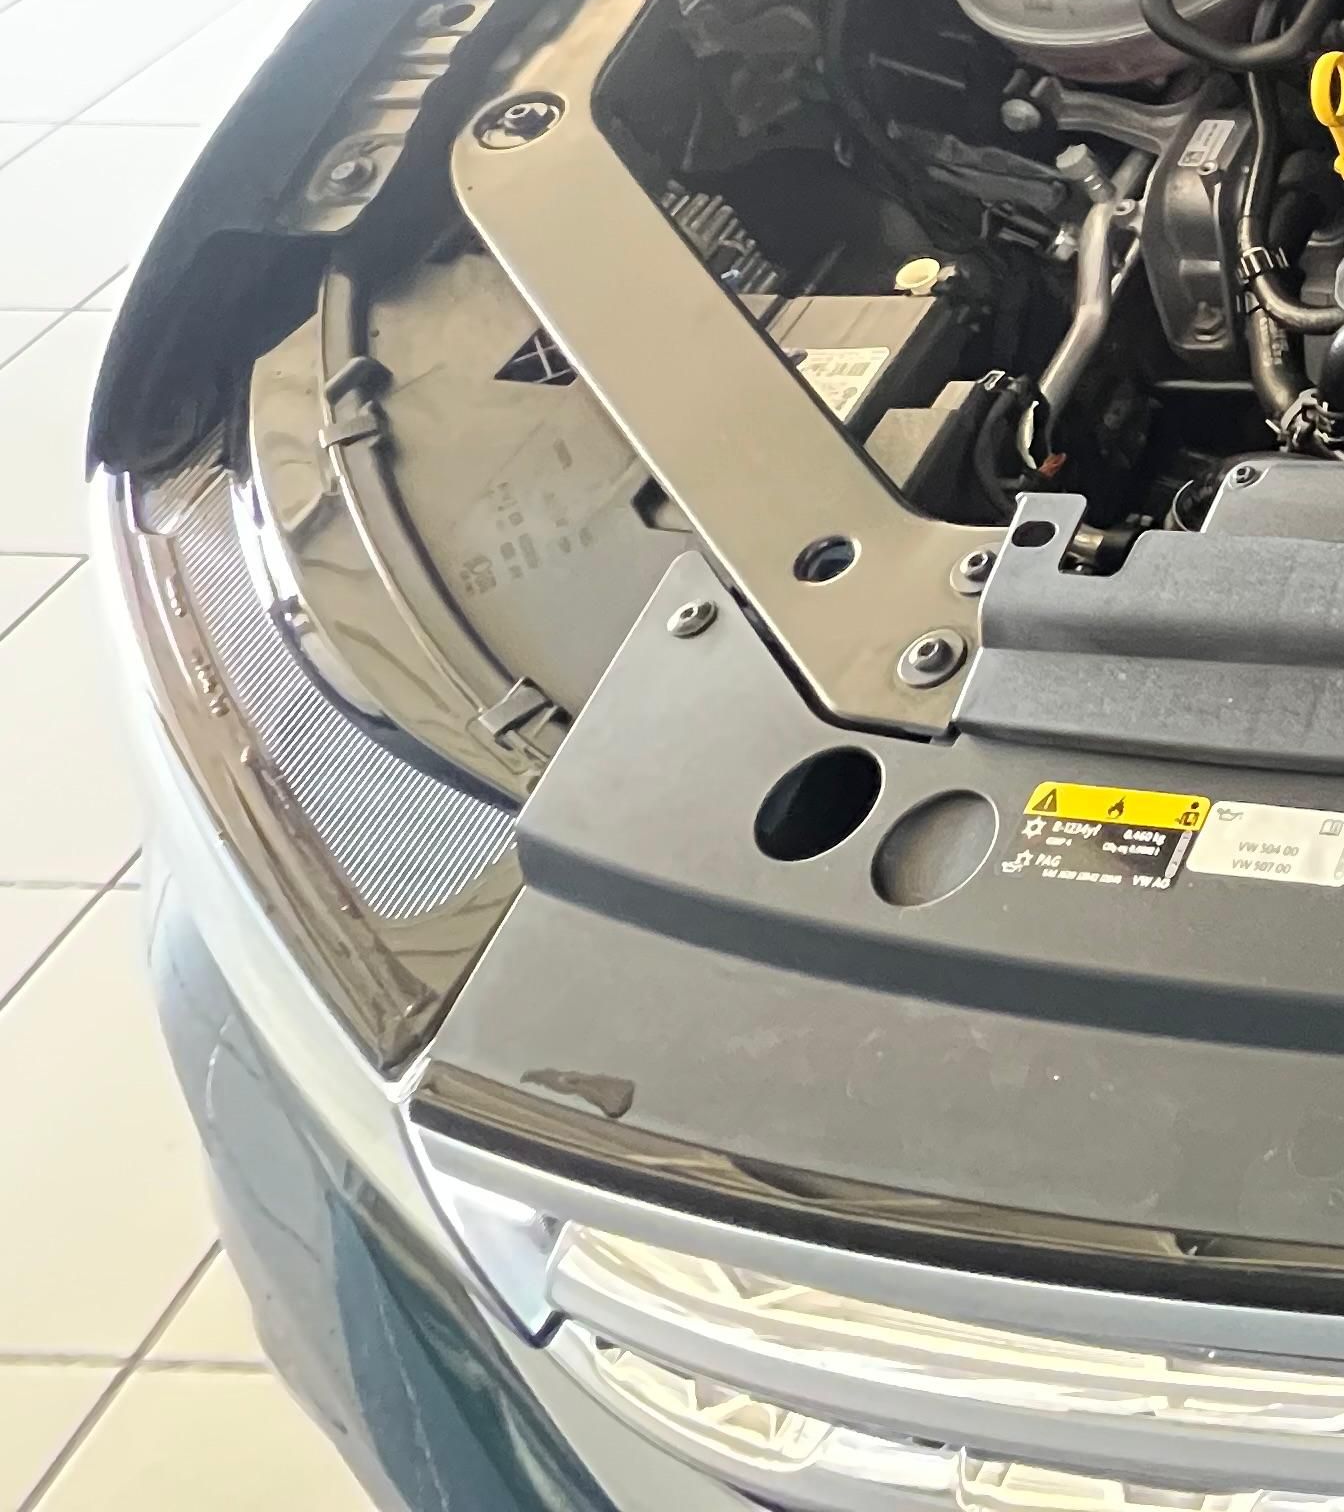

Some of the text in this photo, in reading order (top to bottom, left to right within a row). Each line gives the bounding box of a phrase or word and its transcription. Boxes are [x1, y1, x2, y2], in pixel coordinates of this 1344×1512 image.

[1238, 841, 1259, 853] VW
[1282, 845, 1300, 857] 00
[1232, 858, 1253, 870] VW
[1274, 863, 1292, 874] 00
